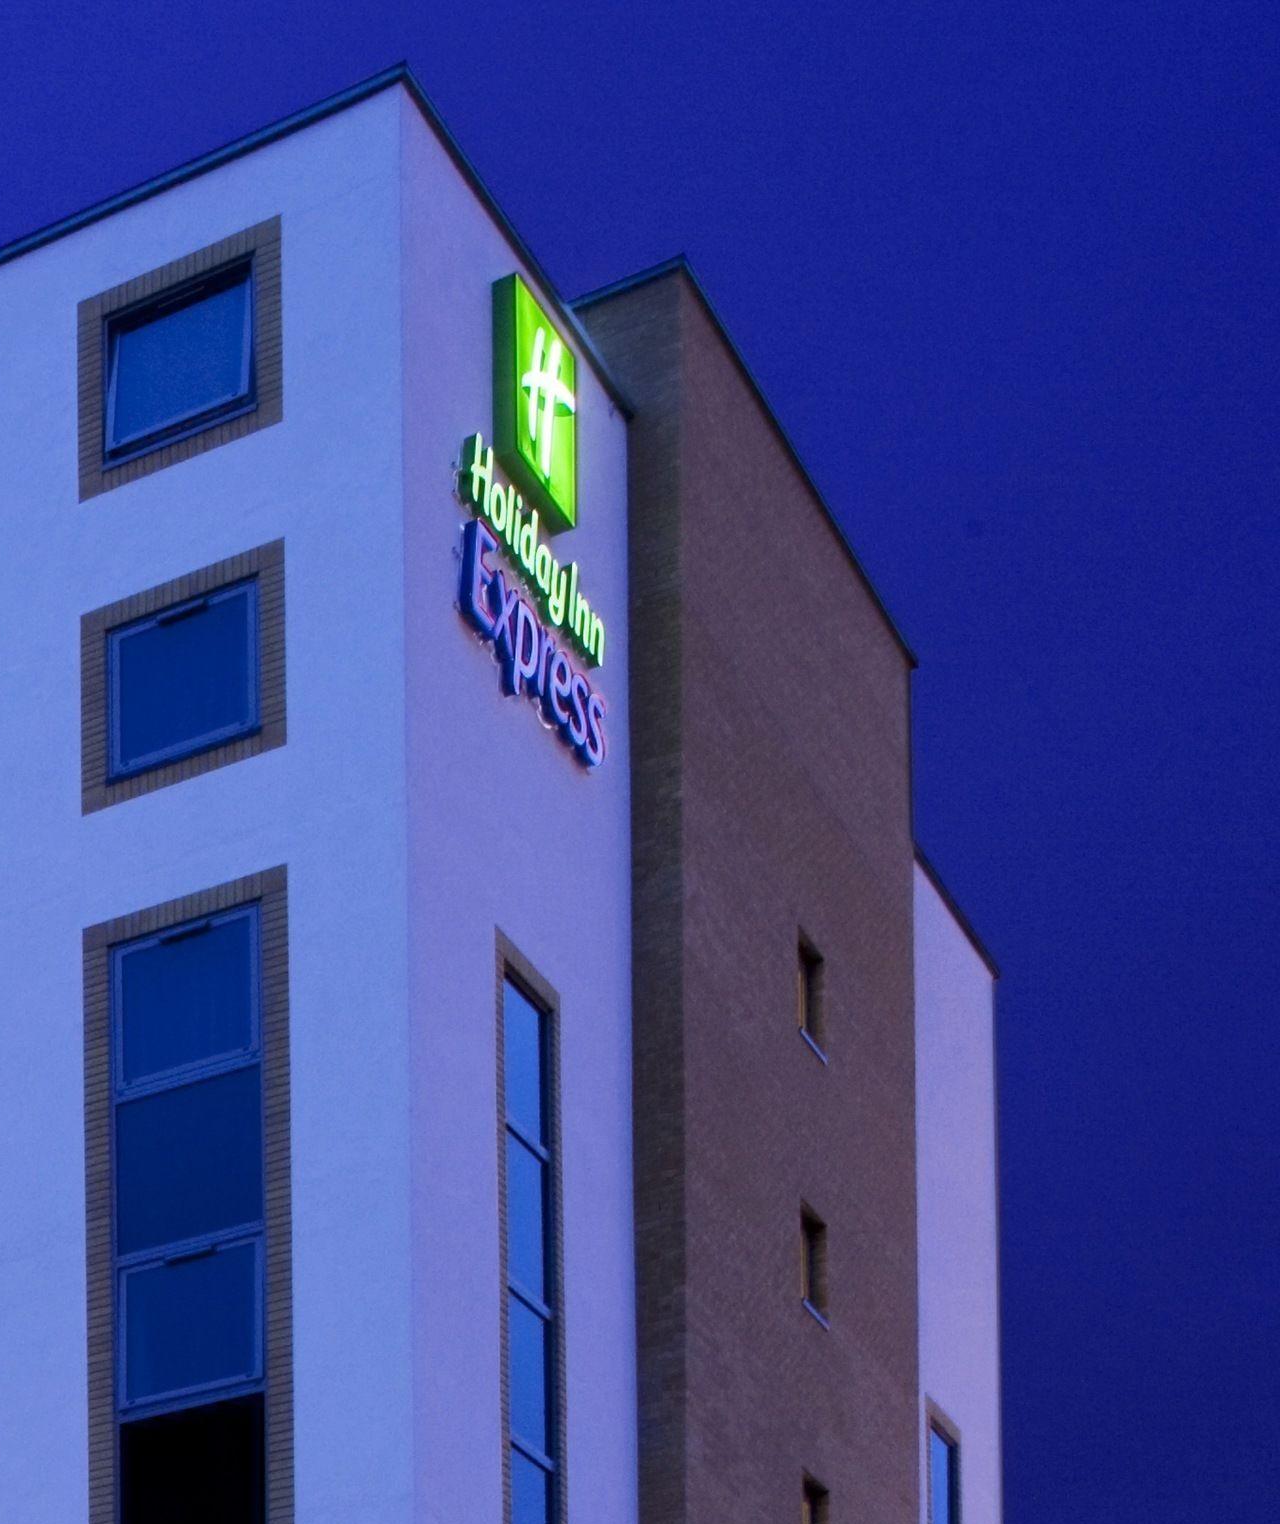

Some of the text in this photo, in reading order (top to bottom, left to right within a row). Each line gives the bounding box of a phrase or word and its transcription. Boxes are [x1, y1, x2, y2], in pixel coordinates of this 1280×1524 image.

[469, 517, 607, 768] Express
[470, 432, 604, 667] Holiday Inn
